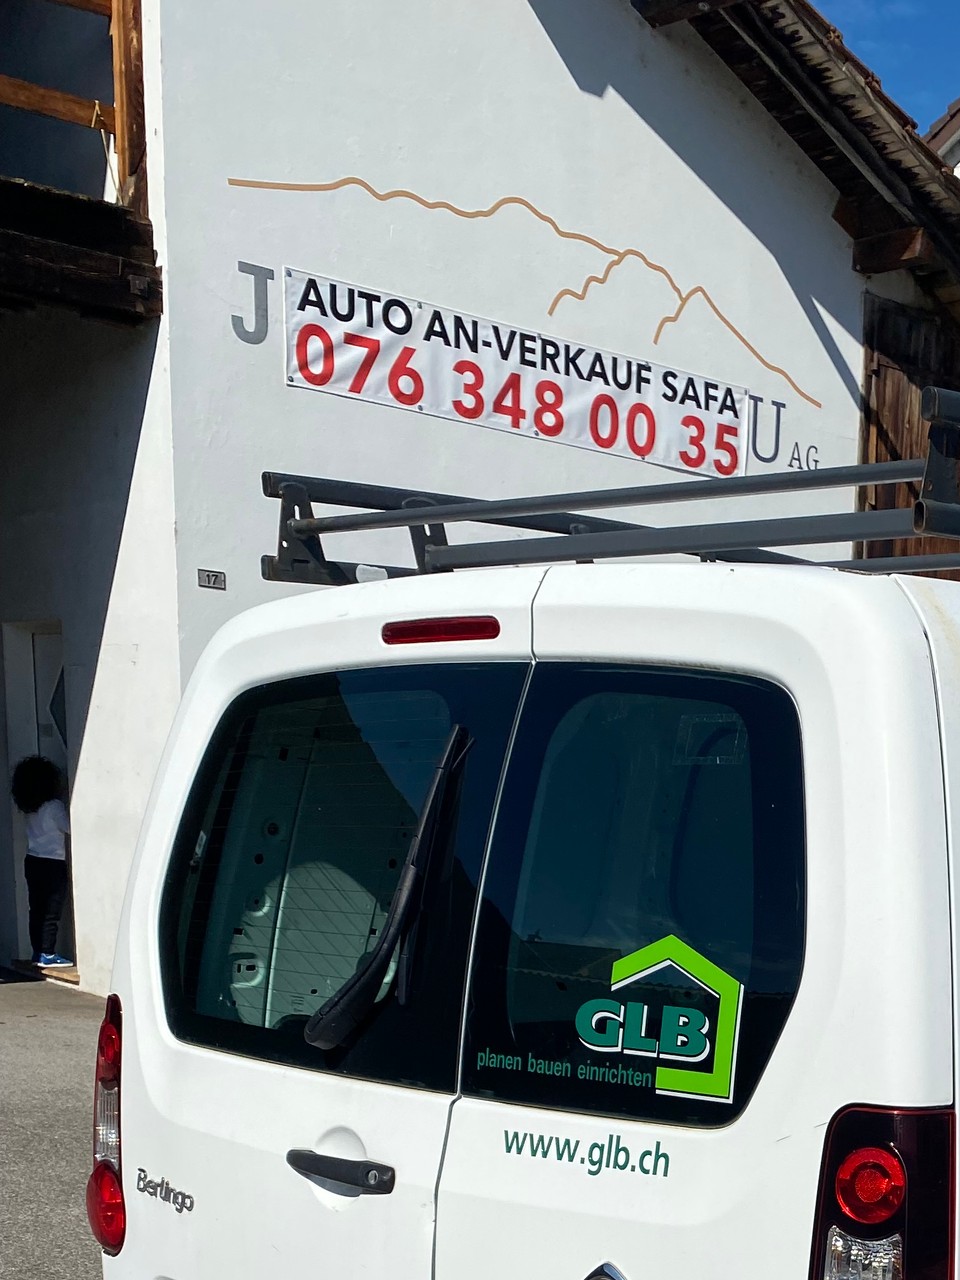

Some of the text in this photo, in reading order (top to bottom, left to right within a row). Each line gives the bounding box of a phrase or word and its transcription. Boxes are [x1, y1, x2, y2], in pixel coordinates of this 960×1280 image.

[296, 278, 741, 419] AUTO AN-VERKAUF SAFA
[295, 323, 741, 477] 076 348 00 35
[787, 441, 820, 470] AG
[205, 573, 219, 586] 17
[575, 998, 710, 1062] GLB
[477, 1048, 652, 1088] planen bauen einrichten
[504, 1129, 671, 1178] www.glb.ch
[136, 1167, 194, 1213] Berlingo
